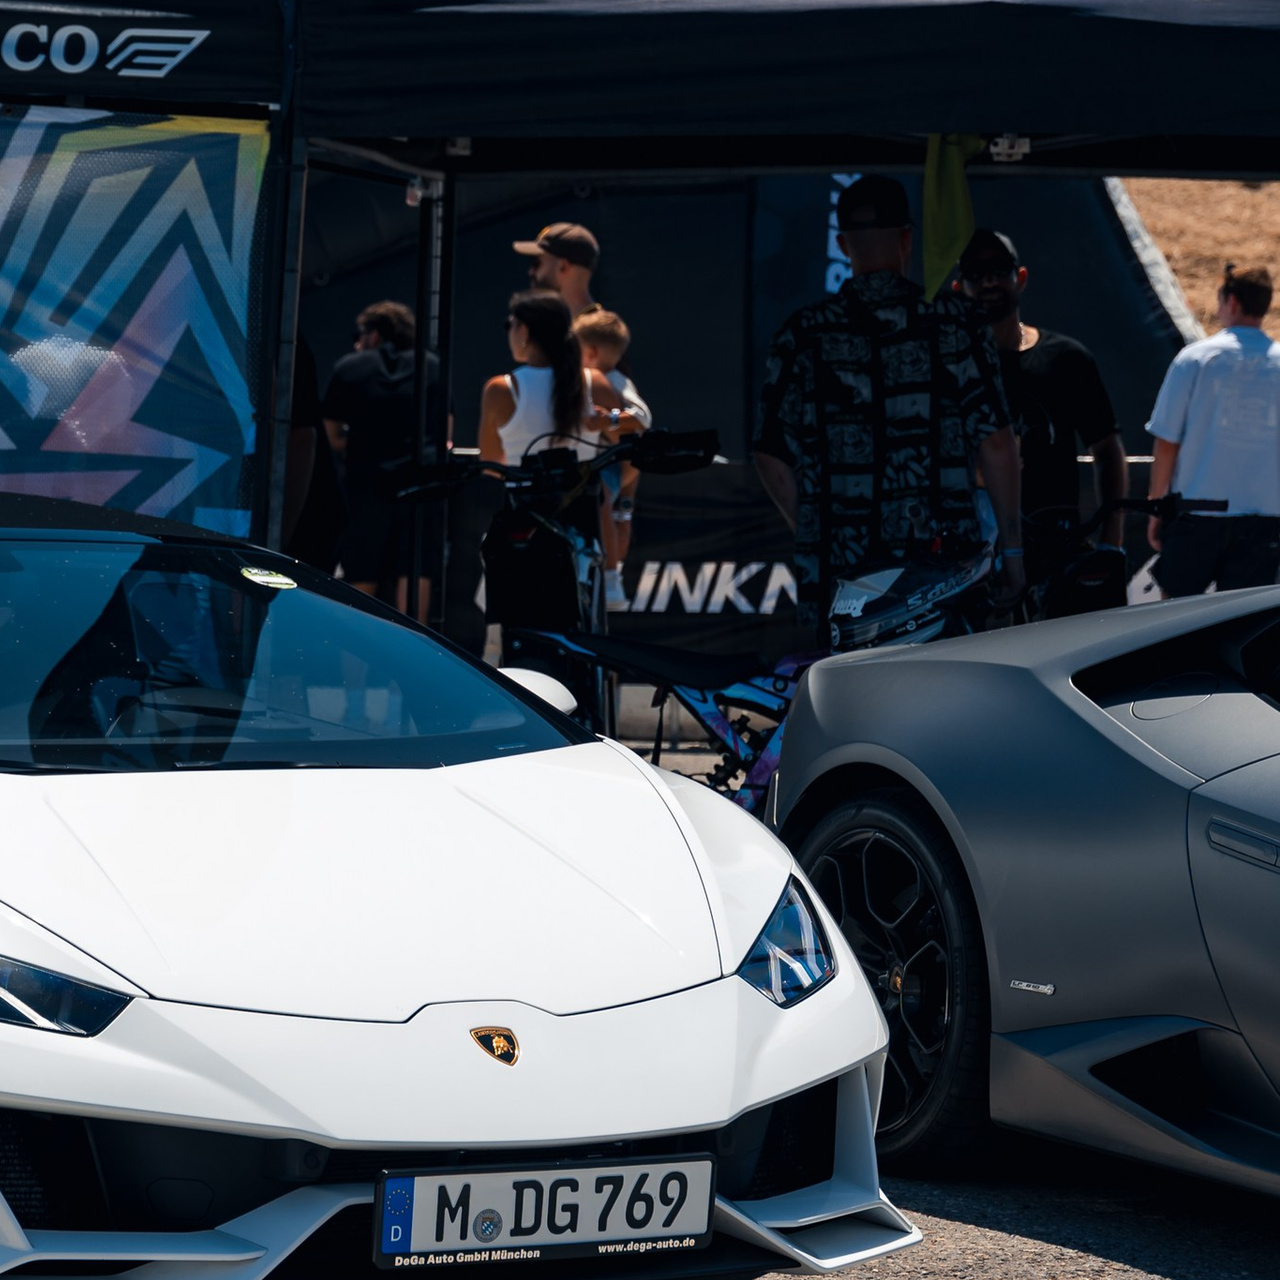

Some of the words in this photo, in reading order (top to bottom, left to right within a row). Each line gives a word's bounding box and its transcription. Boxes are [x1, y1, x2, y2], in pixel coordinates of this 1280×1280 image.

[435, 1183, 471, 1243] M
[510, 1177, 580, 1237] DG
[595, 1171, 688, 1232] 769
[390, 1225, 402, 1242] D
[598, 1237, 696, 1253] www.dega-auto.de
[394, 1254, 425, 1267] DeGa
[426, 1254, 455, 1265] Auto
[456, 1250, 490, 1263] GmbH
[491, 1248, 541, 1261] München
